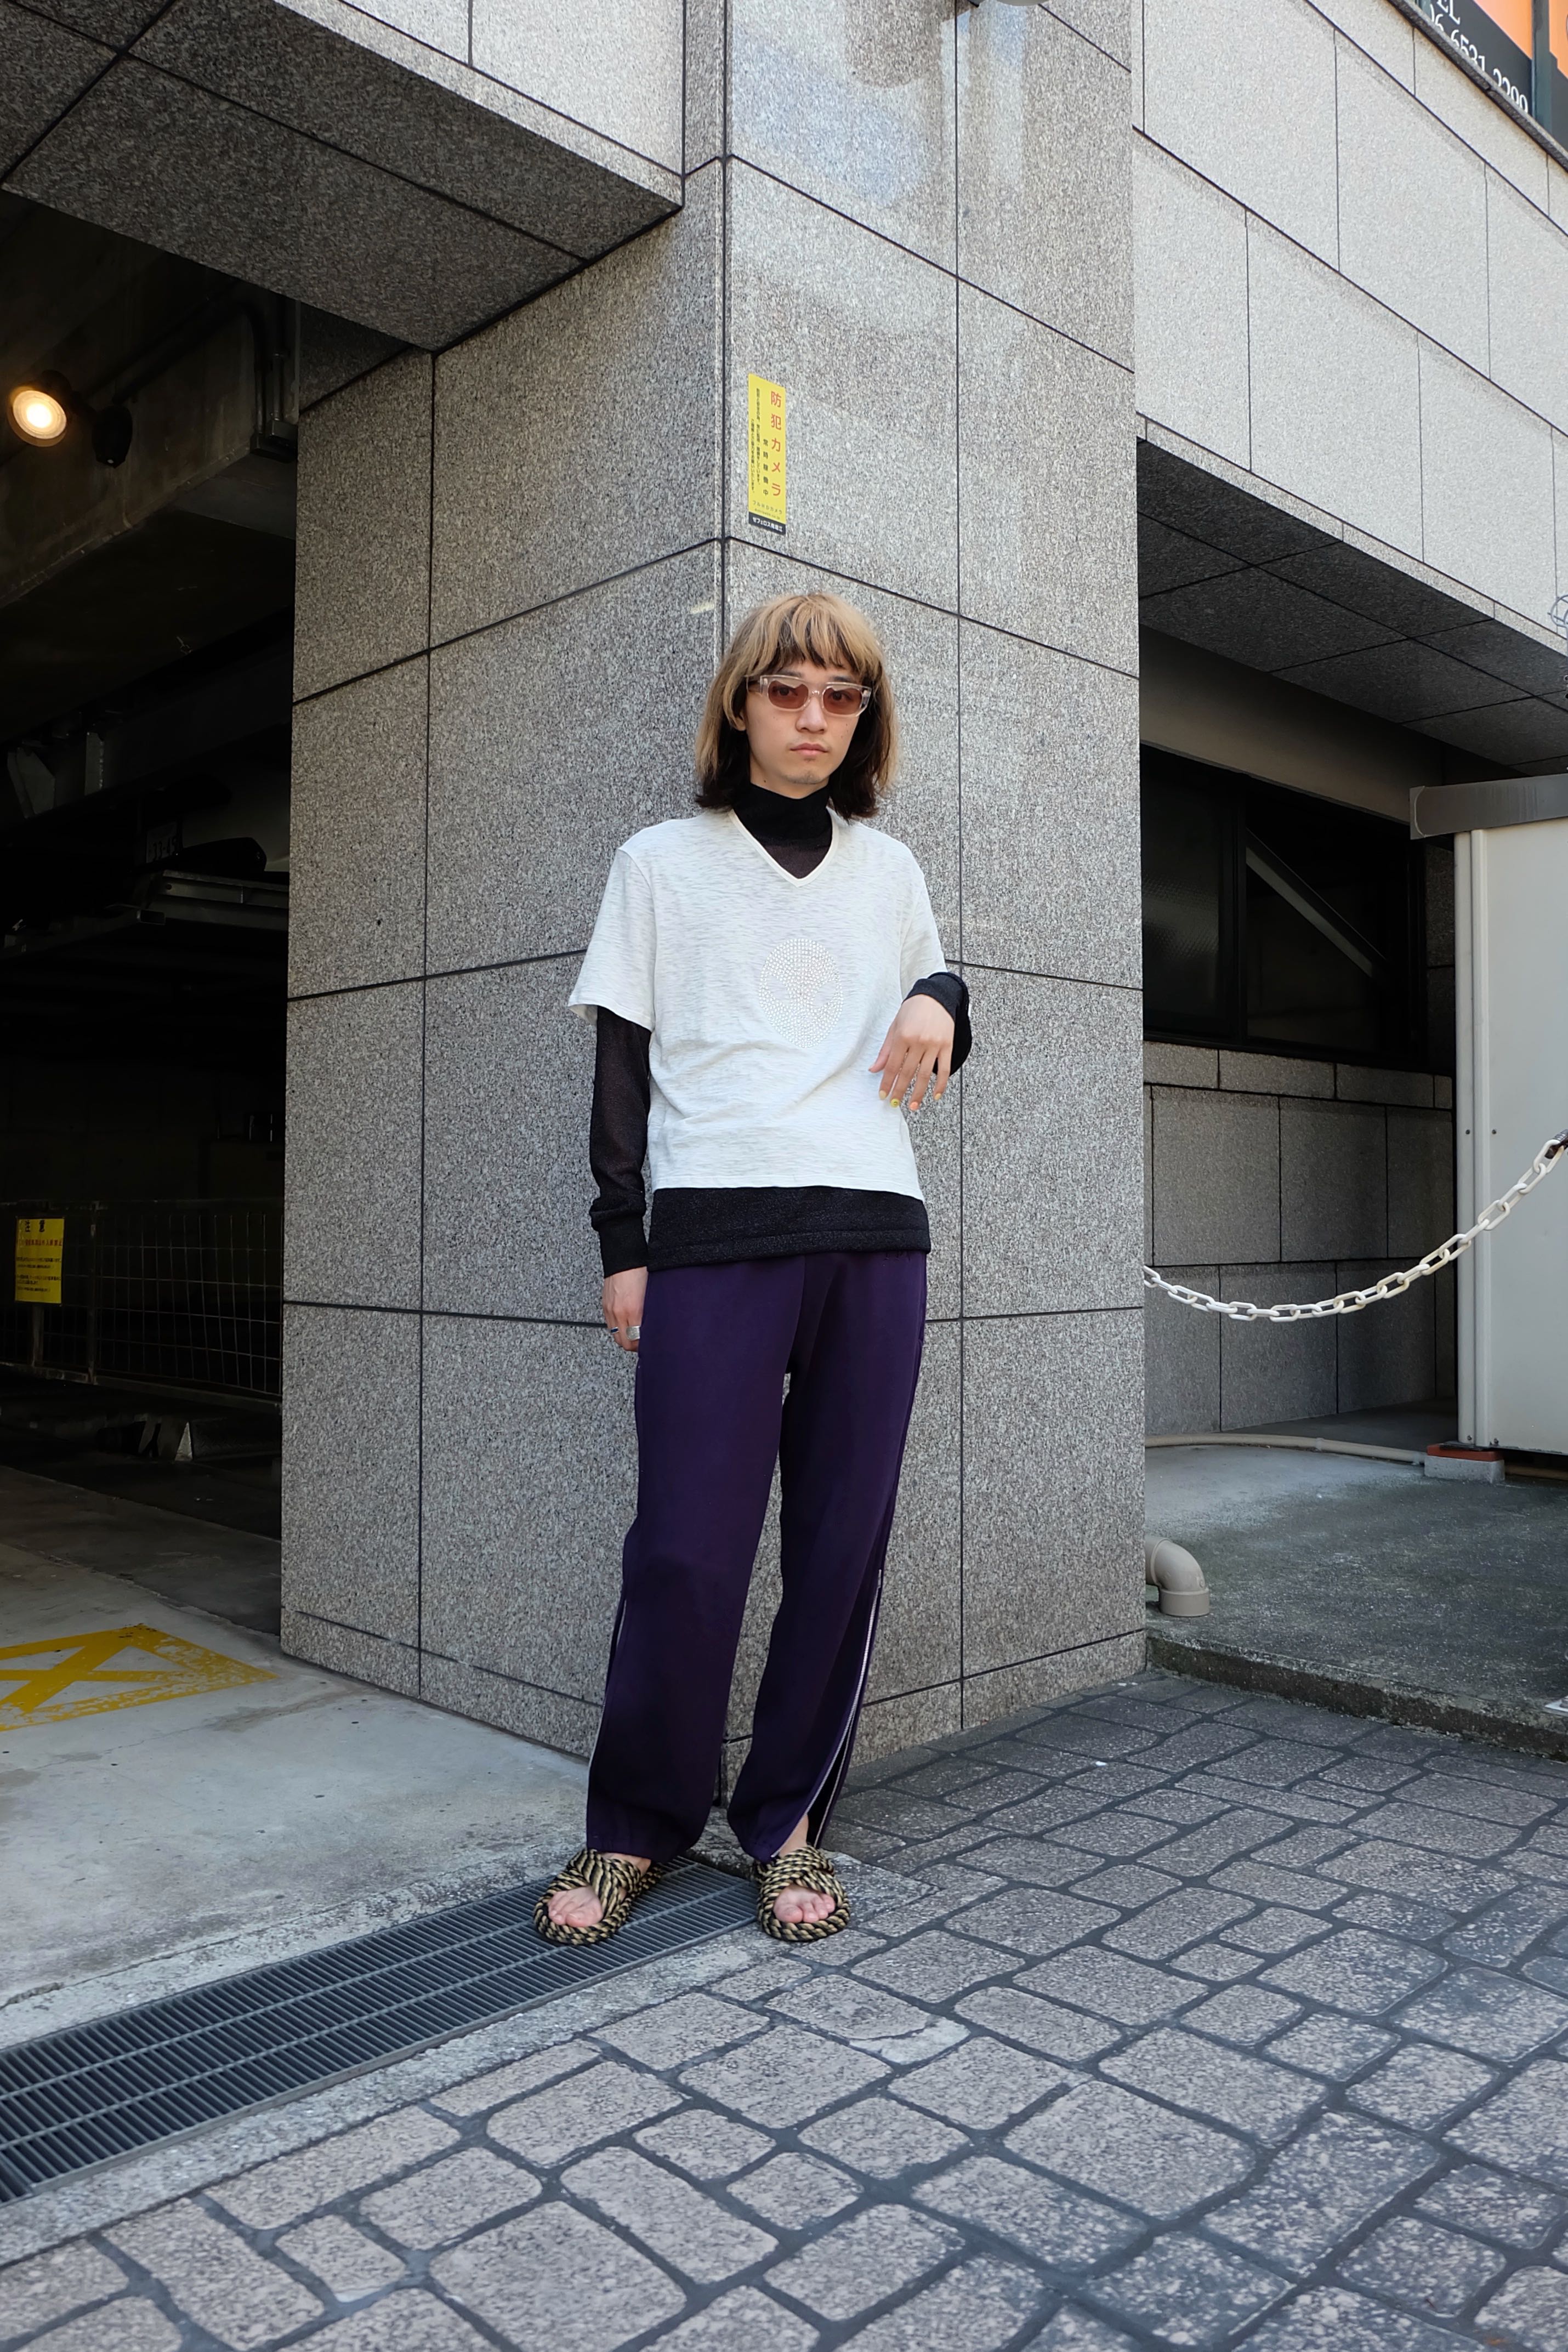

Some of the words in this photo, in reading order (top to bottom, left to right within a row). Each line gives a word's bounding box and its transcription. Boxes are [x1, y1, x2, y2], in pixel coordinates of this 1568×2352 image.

[770, 391, 782, 496] 防犯カメラ
